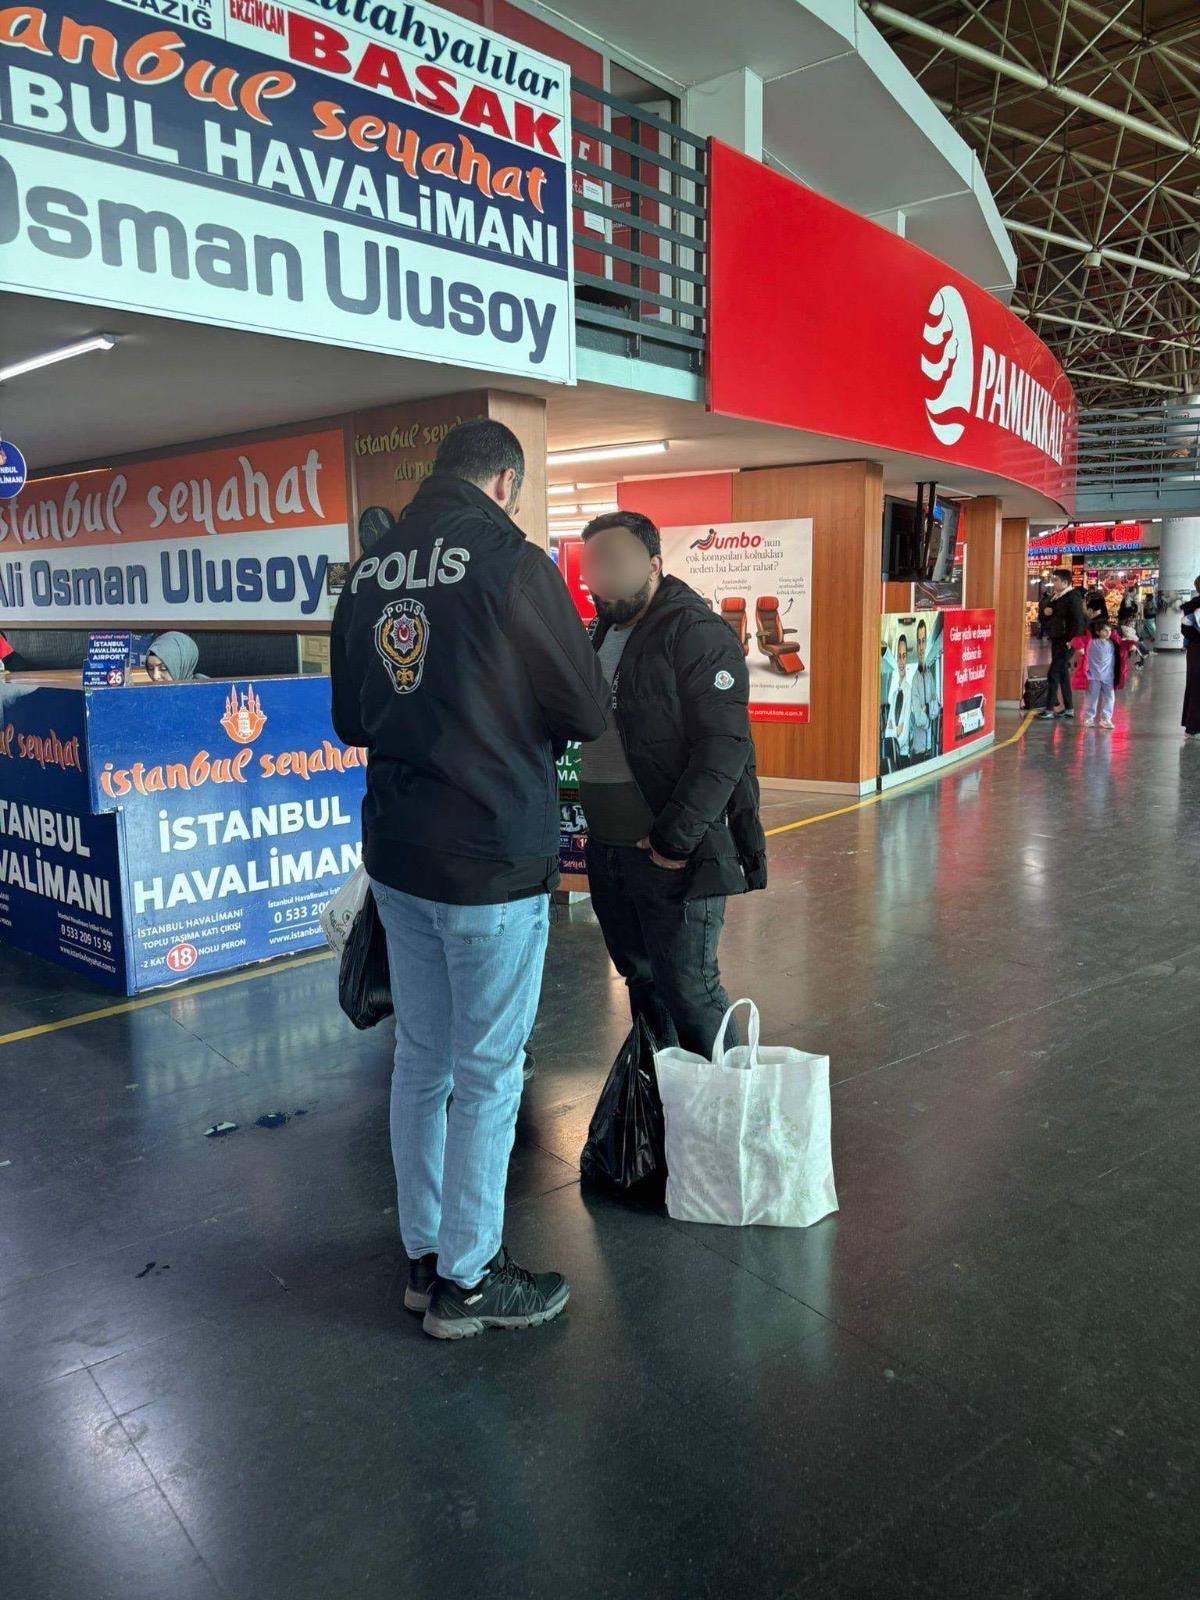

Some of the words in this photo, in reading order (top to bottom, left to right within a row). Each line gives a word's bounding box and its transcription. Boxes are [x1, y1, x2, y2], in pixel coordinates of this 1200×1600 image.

[287, 13, 563, 160] BASAK
[312, 100, 548, 213] seyahat
[204, 119, 559, 267] HAVALİMANI
[323, 229, 557, 364] Ulusoy
[354, 423, 419, 456] istanbul
[147, 449, 326, 535] seyahat
[29, 560, 149, 607] Osman
[159, 549, 329, 615] Ulusoy
[350, 538, 471, 594] POLİS
[690, 566, 714, 574] neden
[716, 564, 727, 573] bu
[729, 562, 751, 571] kadar
[753, 561, 779, 571] rahat?
[386, 600, 422, 617] POLİS
[89, 646, 129, 654] HAVALİMANI
[109, 671, 122, 685] 26
[18, 728, 82, 772] seyahat
[101, 748, 253, 797] istanbul
[159, 796, 351, 853] İSTANBUL
[268, 896, 294, 908] İstanbul
[294, 889, 329, 904] Havalimanı
[274, 911, 283, 924] 0
[286, 906, 308, 922] 533
[60, 923, 66, 935] 0
[66, 926, 79, 941] 533
[79, 930, 92, 945] 209
[93, 935, 101, 949] 15
[102, 940, 112, 953] 59
[137, 922, 184, 939] İSTANBUL
[186, 908, 243, 929] HAVALİMANI
[143, 939, 169, 950] TOPLU
[170, 931, 200, 944] TAŞIMA
[201, 926, 219, 937] KATI
[219, 922, 241, 934] ÇIKIŞI
[150, 956, 166, 967] KAT
[170, 947, 193, 968] 18
[198, 945, 220, 956] NOLU
[221, 938, 246, 951] PERON
